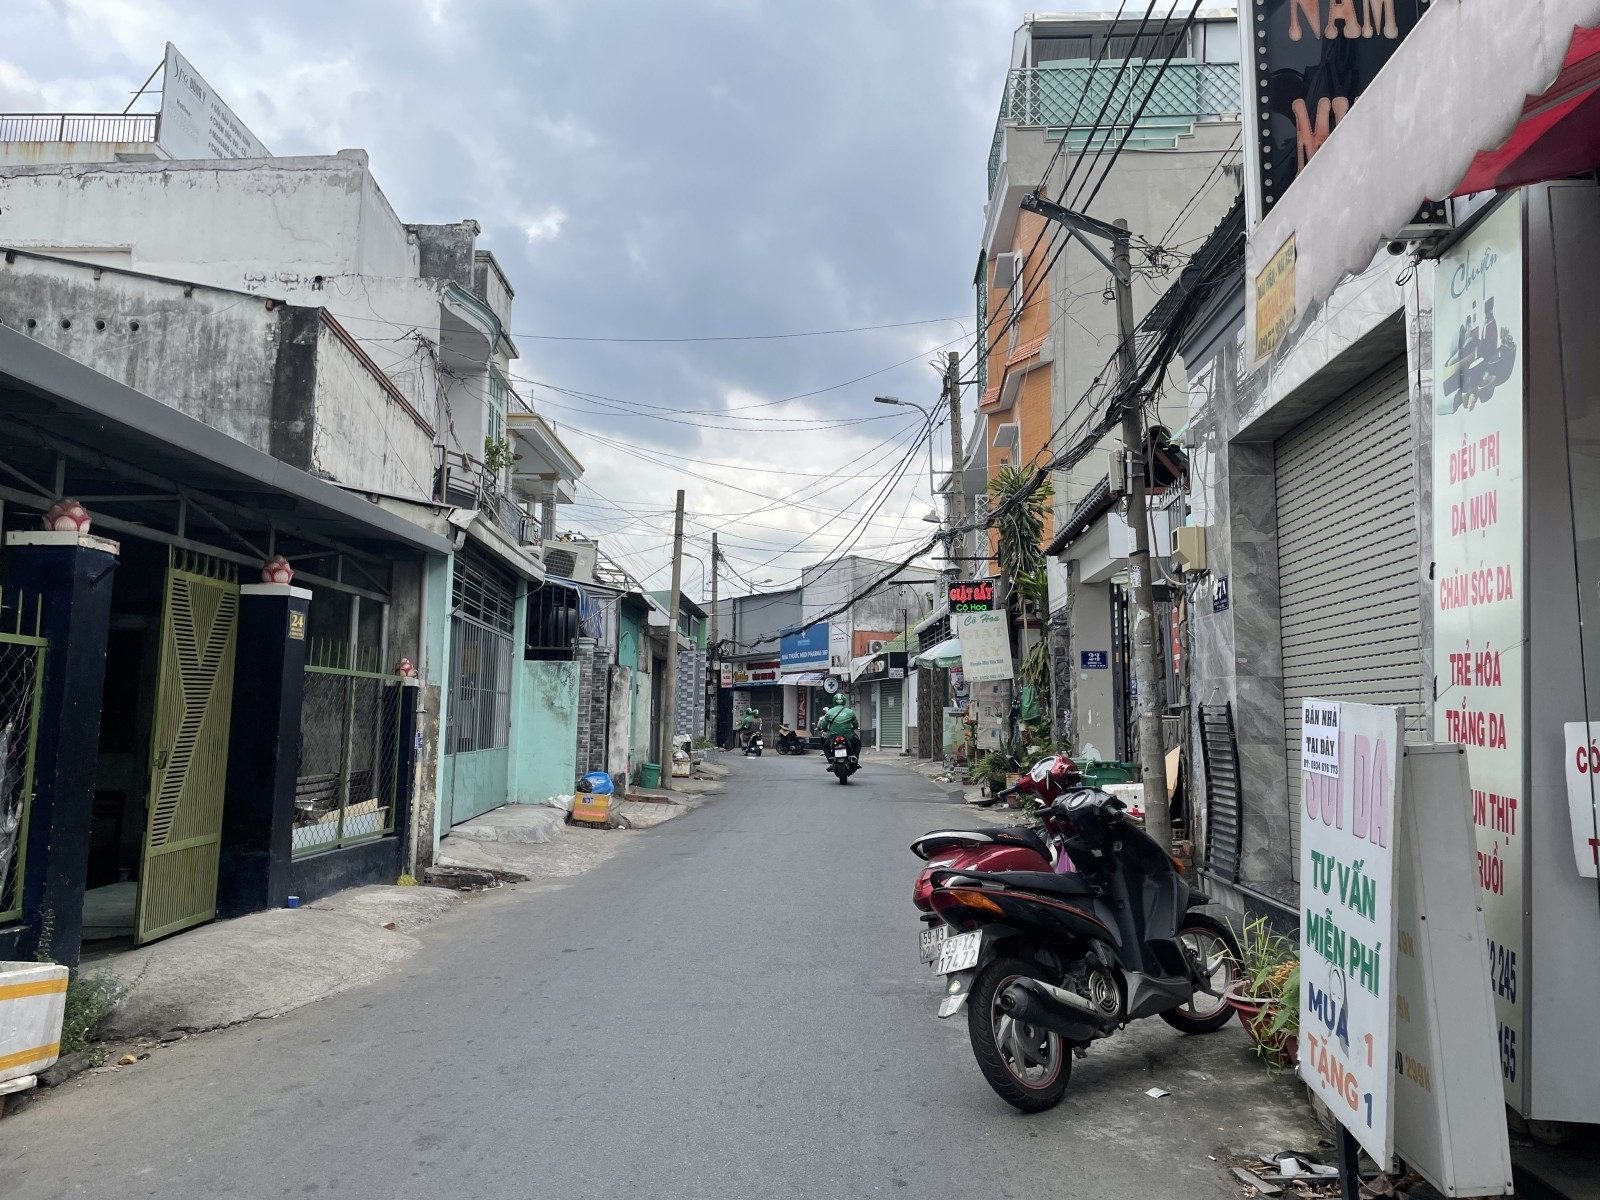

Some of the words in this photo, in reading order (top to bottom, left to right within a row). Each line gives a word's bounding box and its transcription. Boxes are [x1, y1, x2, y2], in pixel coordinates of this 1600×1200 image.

[1450, 247, 1498, 300] Chuyên
[1480, 431, 1500, 476] TRỊ
[1451, 502, 1466, 536] DA
[1470, 490, 1497, 538] MỤN
[949, 584, 973, 603] GIẶT
[973, 582, 993, 601] SẤY
[956, 603, 969, 611] Cô
[970, 603, 987, 611] Hoa
[1440, 568, 1468, 611] CHĂM
[1471, 560, 1493, 606] SÓC
[1497, 564, 1513, 602] DA
[292, 615, 304, 627] 24
[963, 615, 977, 627] Cô
[980, 613, 1000, 624] Hoa
[1088, 652, 1101, 661] 23
[1449, 639, 1471, 686] TRẺ
[1475, 641, 1502, 687] HÓA
[1305, 706, 1320, 725] BÁN
[1321, 706, 1338, 727] NHÀ
[1446, 696, 1485, 747] TRẮNG
[1489, 713, 1507, 750] DA
[1306, 736, 1319, 757] TẠI
[1320, 735, 1335, 757] ĐÂY
[1489, 793, 1517, 845] THỊT
[1311, 849, 1335, 895] TƯ
[1337, 859, 1377, 923] VẤN
[1306, 907, 1346, 971] MIỄN
[1349, 936, 1382, 998] PHÍ
[1498, 944, 1516, 1004] 245
[1308, 981, 1350, 1047] MUA
[1364, 1032, 1374, 1069] 1
[1307, 1031, 1359, 1112] TẶNG
[1364, 1092, 1373, 1129] 1
